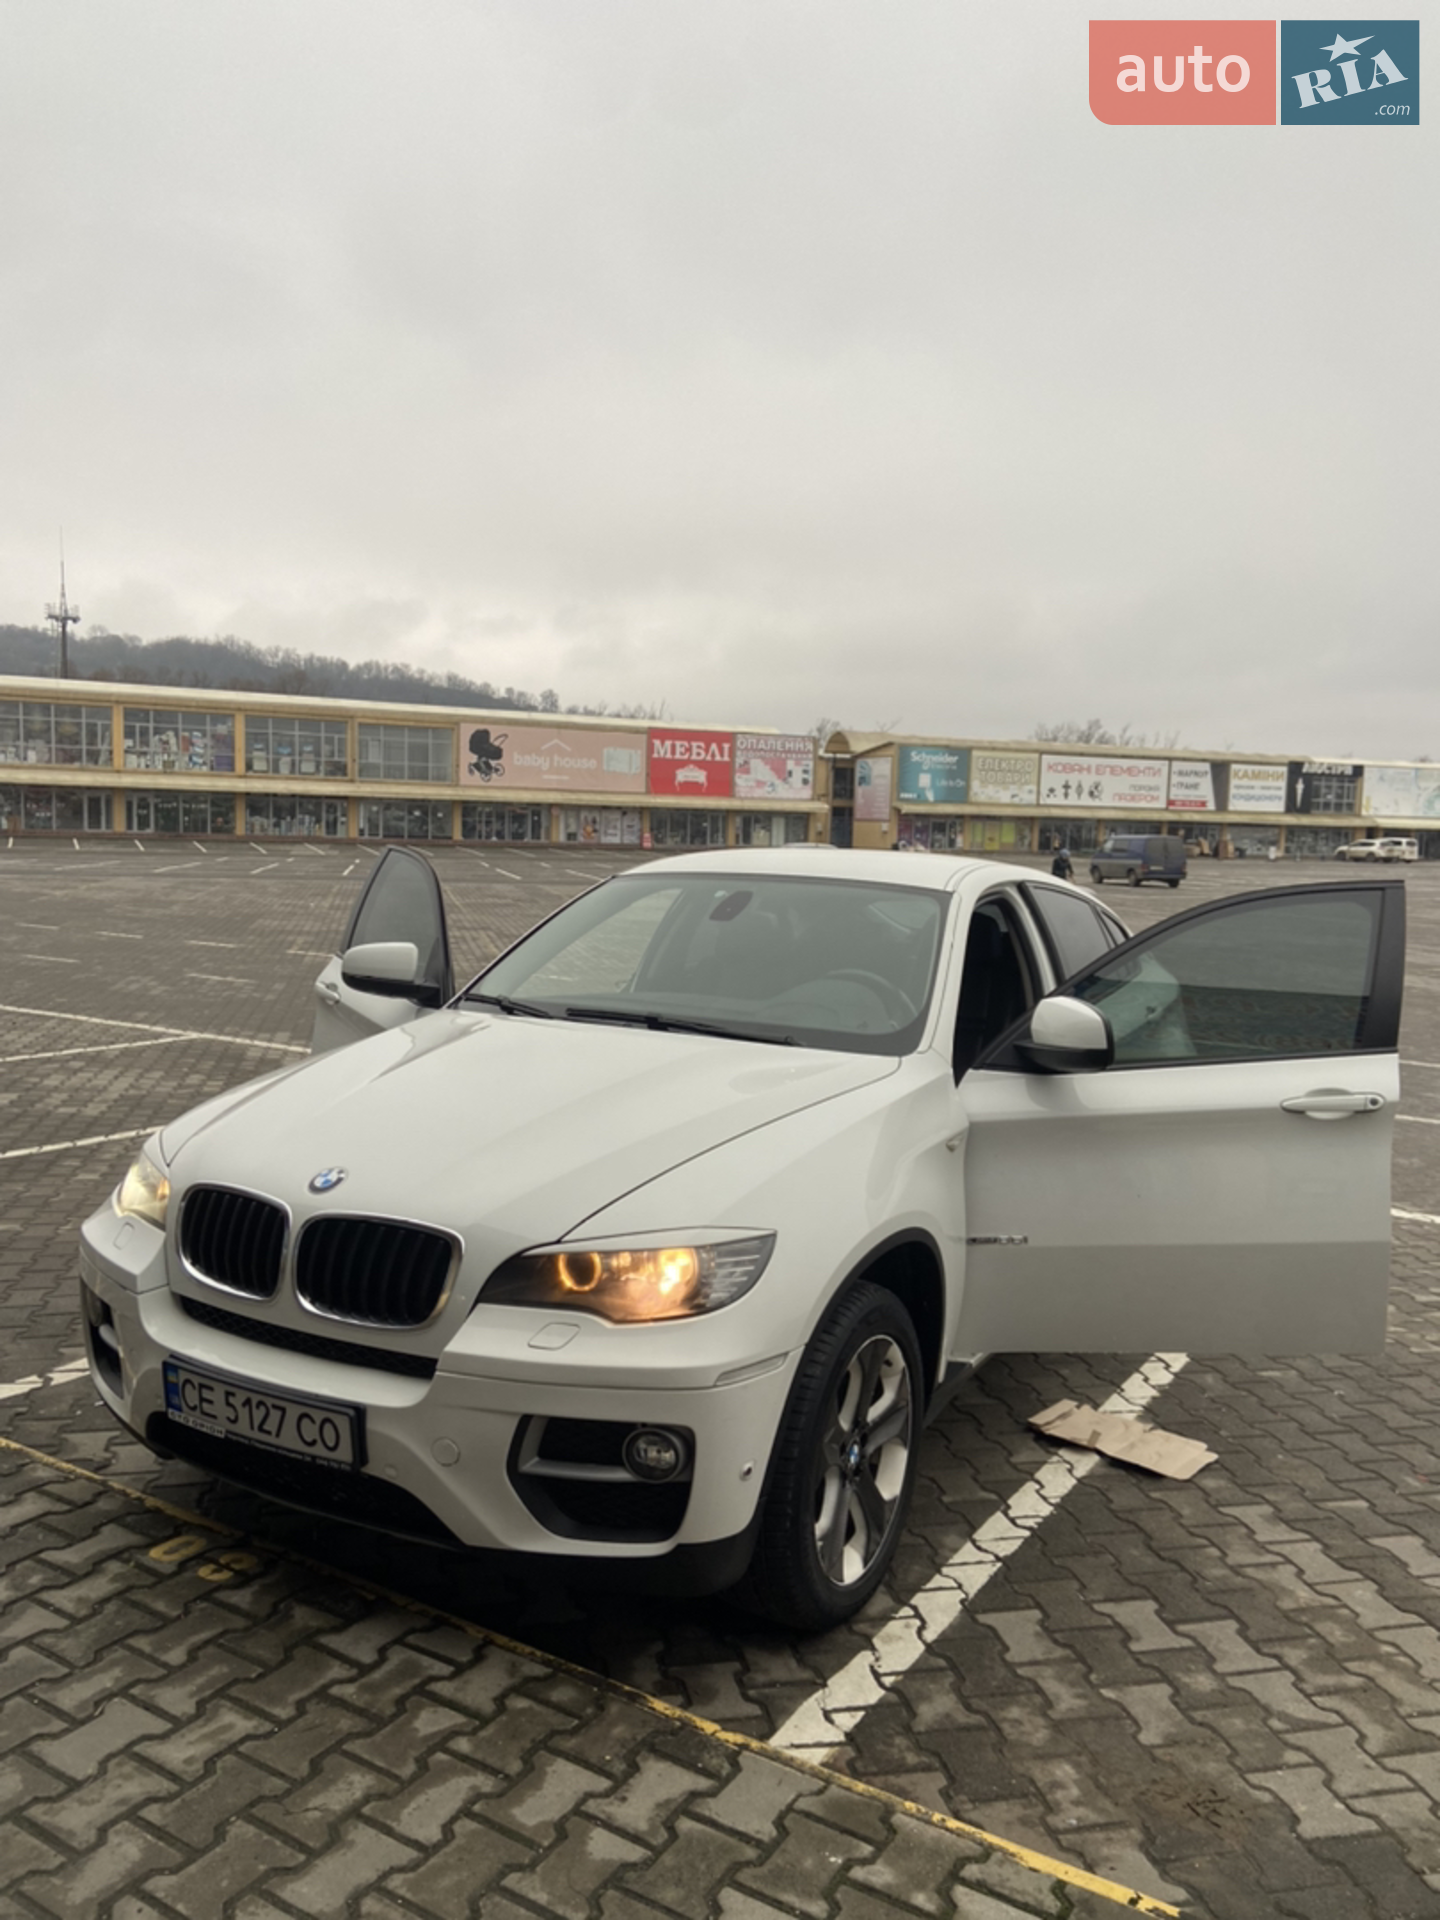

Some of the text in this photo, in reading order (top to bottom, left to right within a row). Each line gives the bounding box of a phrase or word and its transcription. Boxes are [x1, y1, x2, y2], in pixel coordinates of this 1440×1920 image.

[652, 739, 731, 762] МЕБЛІ
[737, 738, 813, 752] ОПАЛЕННЯ
[513, 752, 597, 771] baby house
[910, 750, 959, 770] Schneider
[1046, 762, 1162, 778] КОВАНІ ЕЛЕМЕНТИ
[1233, 768, 1285, 782] КАМІНИ
[181, 1378, 218, 1420] CE
[224, 1391, 287, 1439] 5127
[296, 1411, 341, 1453] CO
